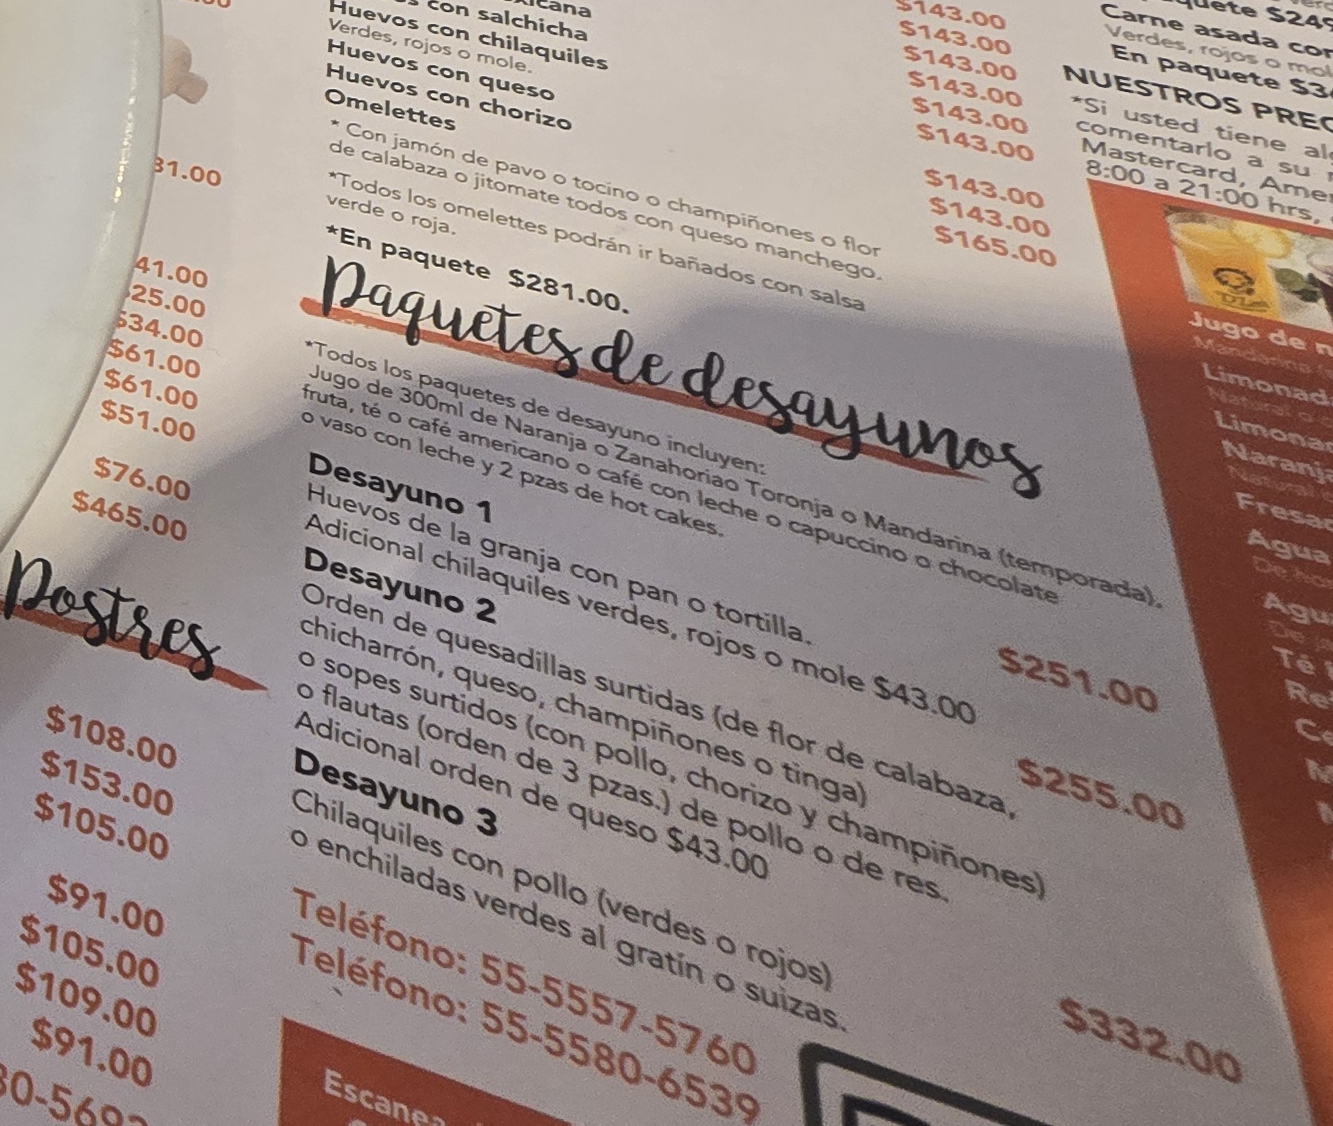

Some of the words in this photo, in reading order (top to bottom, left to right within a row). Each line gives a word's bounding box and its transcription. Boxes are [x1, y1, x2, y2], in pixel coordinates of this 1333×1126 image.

[425, 22, 470, 42] con
[477, 30, 609, 71] chilaquiles
[1099, 2, 1185, 32] Carne
[1193, 23, 1280, 50] asada
[323, 87, 457, 132] Omelettes
[906, 69, 1024, 108] $143.00
[1061, 63, 1243, 116] NUESTROS
[1080, 136, 1246, 189] Mastercard,
[1085, 159, 1146, 186] 8:00
[1153, 177, 1171, 191] a
[1179, 178, 1259, 210] 21:00
[1268, 194, 1321, 226] hrs,
[380, 241, 492, 280] paquete
[507, 268, 630, 315] $281.00.
[932, 223, 1058, 268] $165.00
[107, 338, 202, 379] $61.00
[1188, 310, 1259, 341] Jugo
[1266, 328, 1308, 352] de
[321, 254, 584, 378] Paquetes
[590, 328, 674, 386] de
[681, 350, 1044, 501] desayunos
[99, 398, 196, 443] $51.00
[383, 358, 413, 382] los
[418, 372, 517, 409] paquetes
[520, 397, 551, 418] de
[555, 405, 662, 447] desayuno
[666, 433, 767, 476] incluyen:
[92, 455, 192, 502] $76.00
[308, 450, 465, 516] Desayuno
[474, 499, 492, 524] 1
[70, 488, 188, 542] $465.00
[303, 545, 465, 614] Desayuno
[473, 596, 498, 626] 2
[306, 481, 401, 527] Huevos
[407, 511, 442, 538] de
[449, 520, 472, 547] la
[478, 536, 561, 575] granja
[568, 562, 619, 590] con
[626, 578, 680, 608] pan
[686, 595, 707, 614] o
[711, 599, 814, 647] tortilla.
[2, 549, 223, 681] Postres
[994, 645, 1162, 714] $251.00
[44, 703, 178, 770] $108.00
[39, 748, 175, 817] $153.00
[293, 745, 466, 827] Desayuno
[473, 806, 499, 838] 3
[1017, 757, 1186, 831] $255.00
[32, 790, 171, 862] $105.00
[45, 871, 166, 939] $91.00
[290, 787, 444, 859] Chilaquiles
[450, 846, 505, 880] con
[511, 864, 589, 907] pollo
[595, 886, 708, 947] (verdes
[715, 933, 737, 956] o
[744, 942, 834, 994] rojos)
[13, 959, 158, 1039] $109.00
[291, 885, 468, 976] Teléfono:
[479, 950, 759, 1077] 55-5557-5760
[289, 930, 468, 1026] Teléfono:
[479, 998, 762, 1123] 55-5580-6539
[1059, 996, 1243, 1085] $332.00
